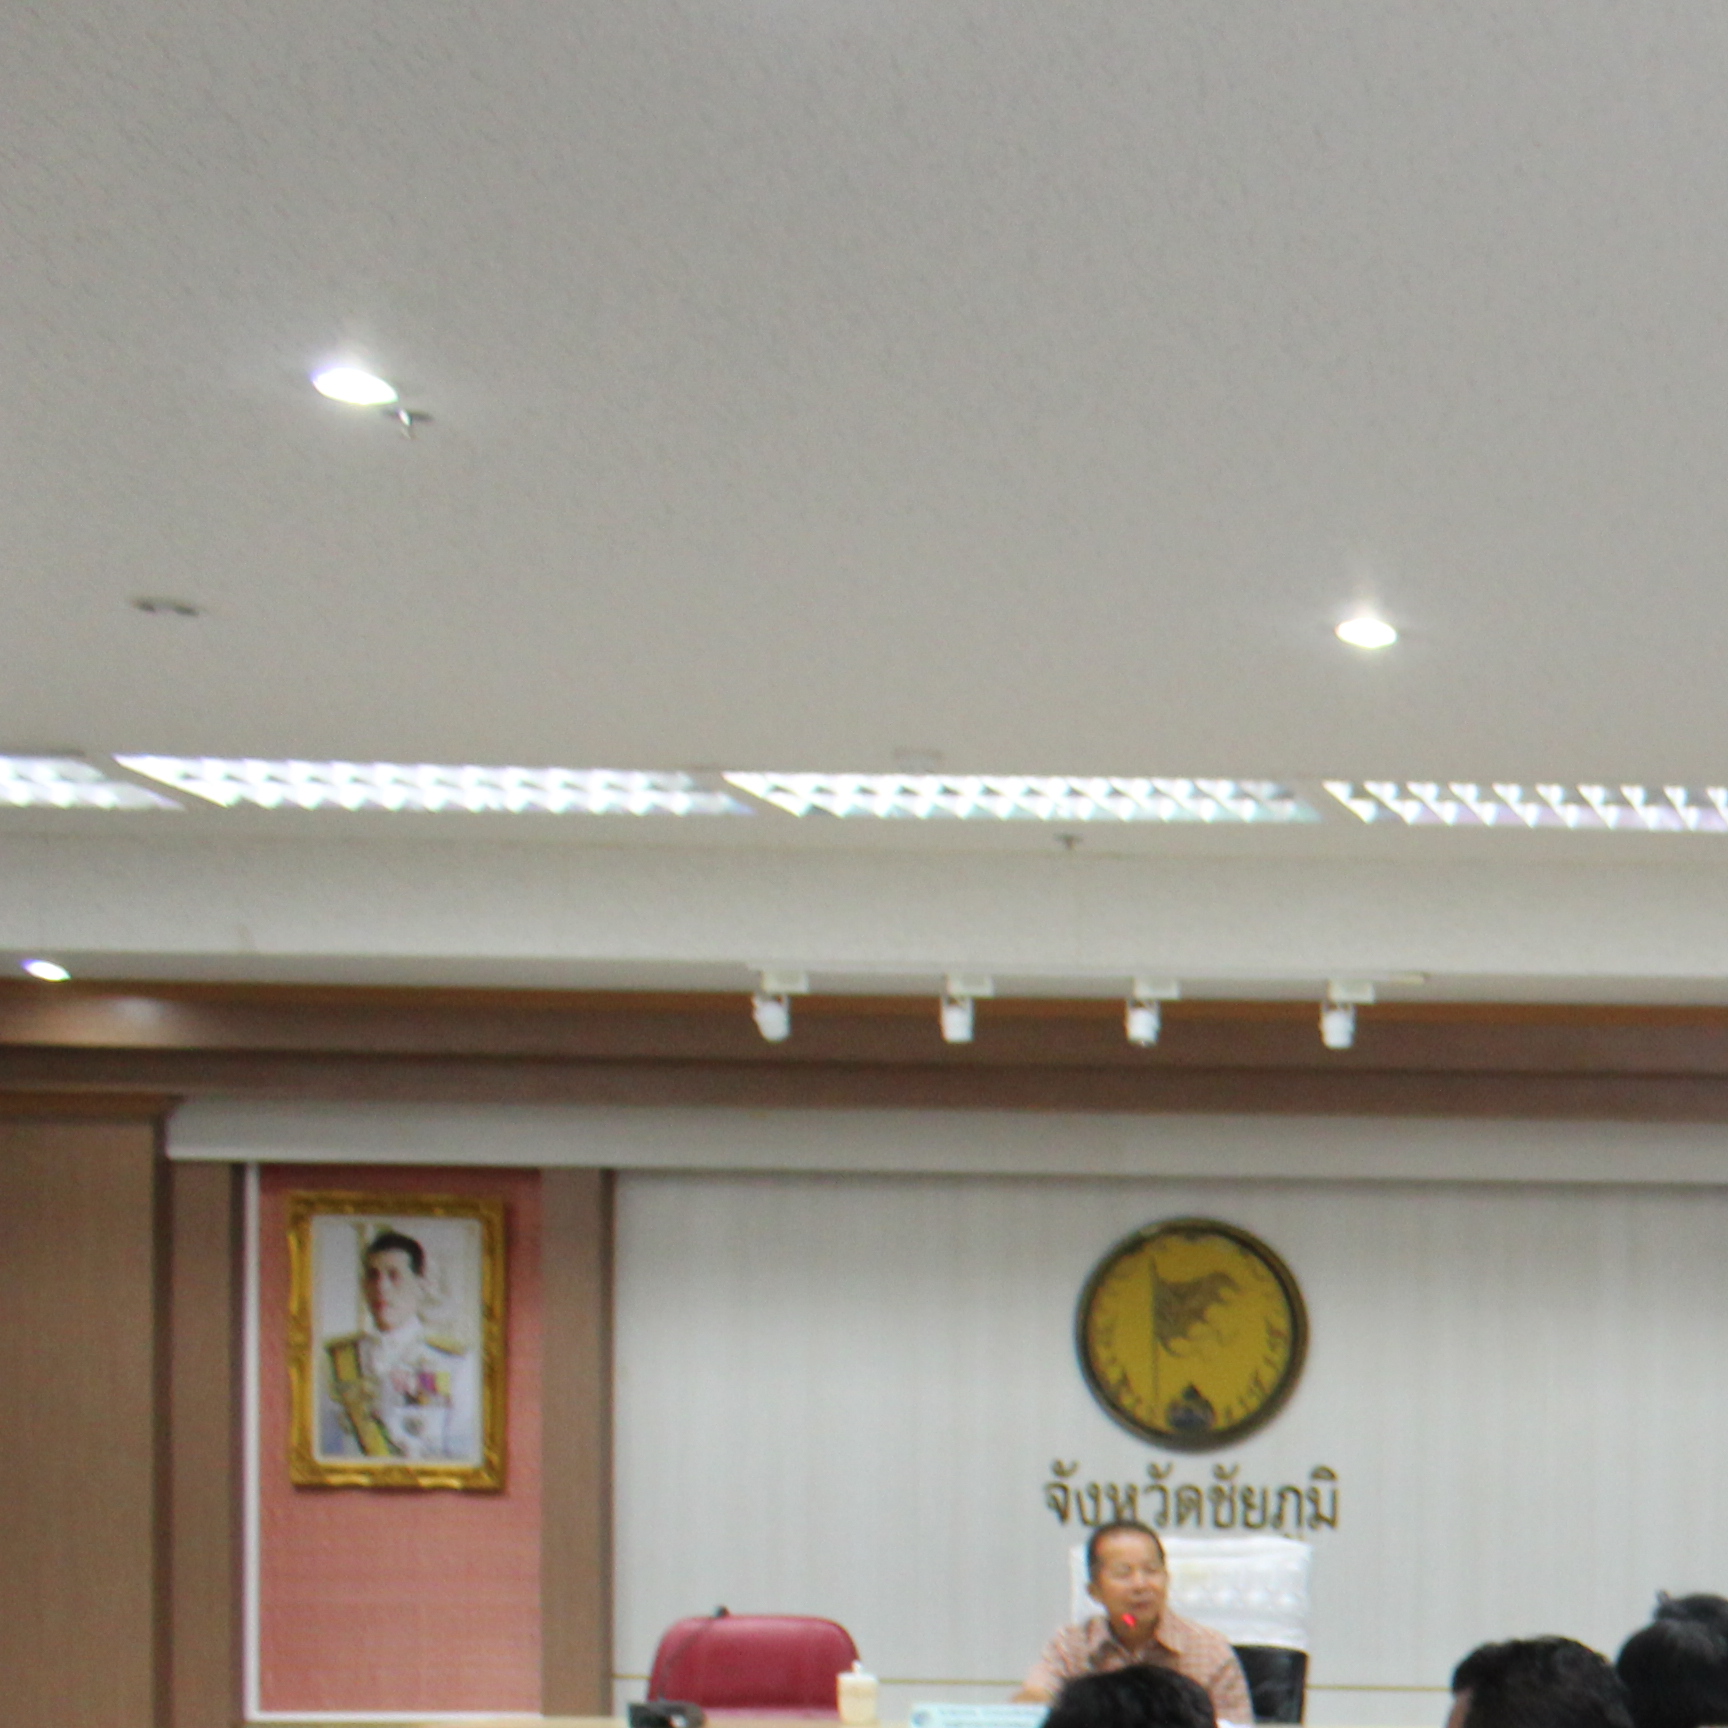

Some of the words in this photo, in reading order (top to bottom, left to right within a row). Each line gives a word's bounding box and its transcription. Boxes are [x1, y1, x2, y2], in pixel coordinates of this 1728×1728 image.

[1043, 1458, 1340, 1540] จังหวัดชัยภูมิ
